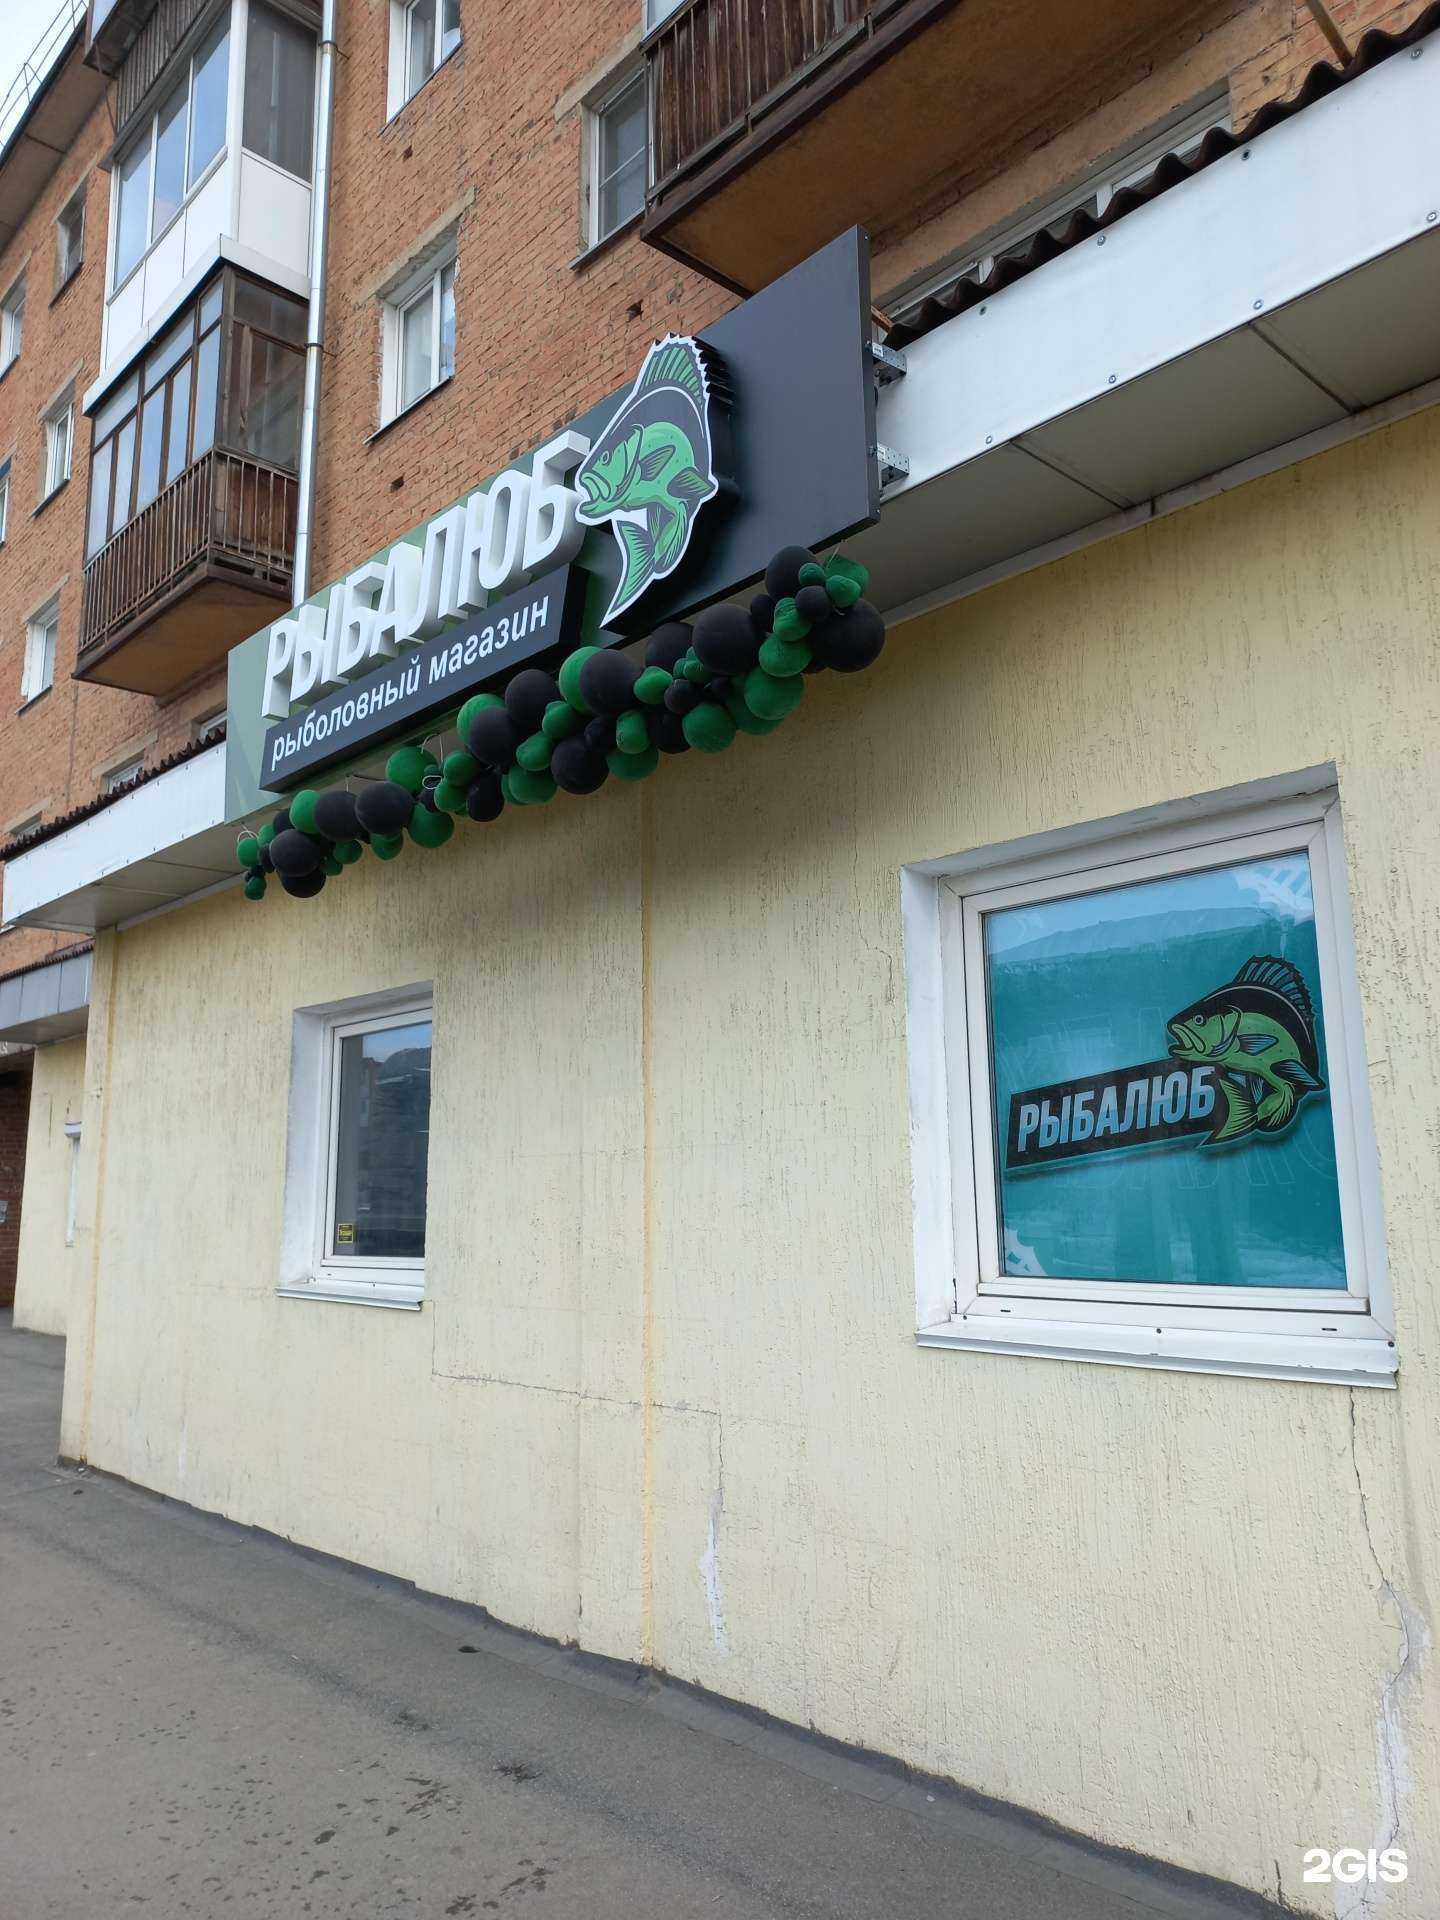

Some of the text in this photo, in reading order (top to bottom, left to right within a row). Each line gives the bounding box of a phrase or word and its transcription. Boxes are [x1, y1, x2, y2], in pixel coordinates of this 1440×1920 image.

[261, 430, 591, 719] РЫБАЛЮБ
[271, 595, 550, 772] рыболовный магазин
[1017, 1065, 1216, 1153] РЫБАЛЮБ
